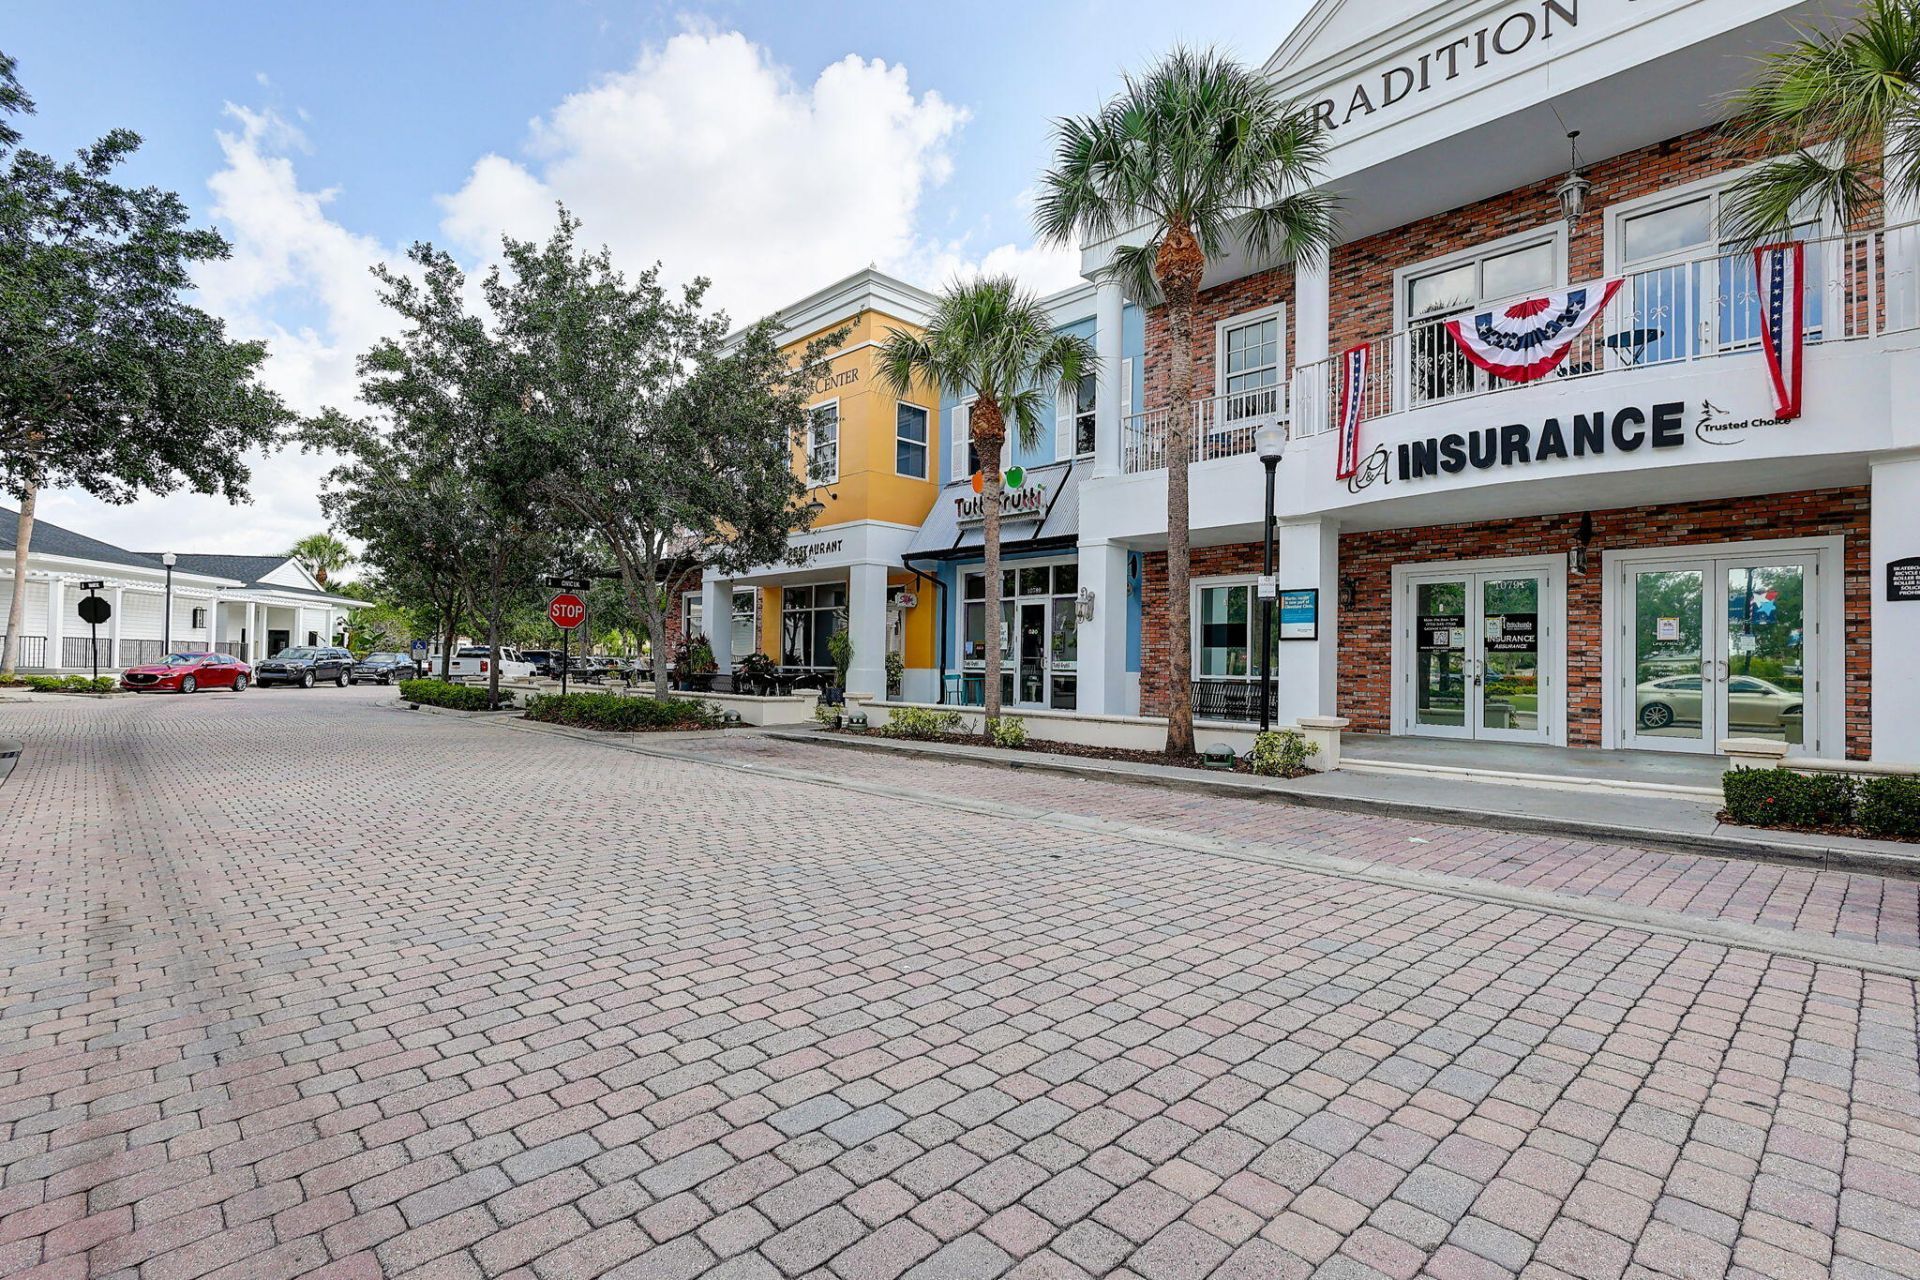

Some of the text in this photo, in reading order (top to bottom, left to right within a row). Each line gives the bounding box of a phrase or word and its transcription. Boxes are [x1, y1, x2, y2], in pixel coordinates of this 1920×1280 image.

[815, 367, 859, 393] CENTER
[1704, 420, 1748, 432] Trusted
[1397, 401, 1685, 480] INSURANCE
[955, 496, 985, 517] Tutt
[552, 603, 583, 618] STOP
